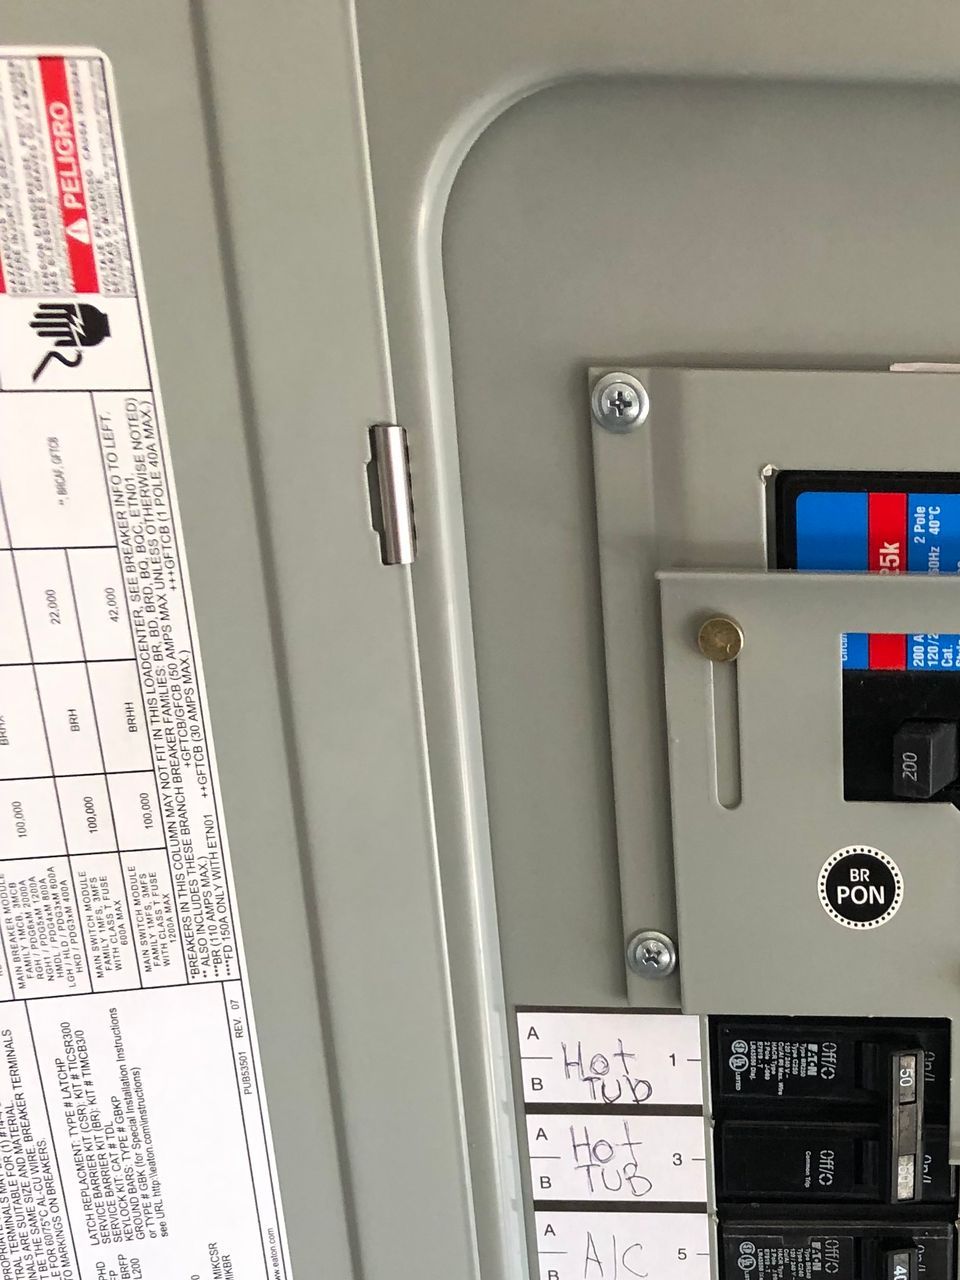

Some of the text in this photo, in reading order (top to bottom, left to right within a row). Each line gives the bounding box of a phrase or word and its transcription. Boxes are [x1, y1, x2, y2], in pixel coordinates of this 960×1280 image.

[50, 101, 84, 210] PELIGRO
[106, 452, 119, 472] TO
[126, 397, 157, 535] OTHERWISE NOTED)
[148, 443, 166, 507] POLE 40A
[110, 475, 125, 507] INFO
[914, 506, 926, 533] Pole
[928, 506, 940, 535] 40°C
[45, 589, 62, 625] 22,000
[104, 587, 120, 623] 42,000
[133, 606, 155, 694] LOADCENTER,
[161, 624, 175, 660] AMPS
[913, 644, 924, 666] 200
[941, 644, 953, 667] Cat.
[70, 708, 82, 733] BRH
[124, 701, 138, 733] BRHH
[179, 650, 208, 798] ++GFTCB AMPS MAX.)
[901, 751, 918, 782] 200
[12, 801, 27, 838] 100,000
[84, 797, 98, 834] 100,000
[139, 793, 153, 830] 100,000
[204, 813, 218, 849] ETN01
[849, 868, 870, 883] BR
[836, 886, 885, 905] PON
[113, 901, 128, 945] 600A MAX
[165, 915, 176, 944] 1200A
[109, 1008, 126, 1062] Instructions
[231, 1000, 244, 1039] REV. 07
[238, 1051, 252, 1095] PUB53501
[560, 1037, 636, 1080] Hot
[55, 1057, 72, 1101] LATCHP
[899, 1068, 913, 1088] 50
[569, 1120, 644, 1165] Hot
[672, 1153, 683, 1165] 3
[677, 1248, 688, 1260] 5
